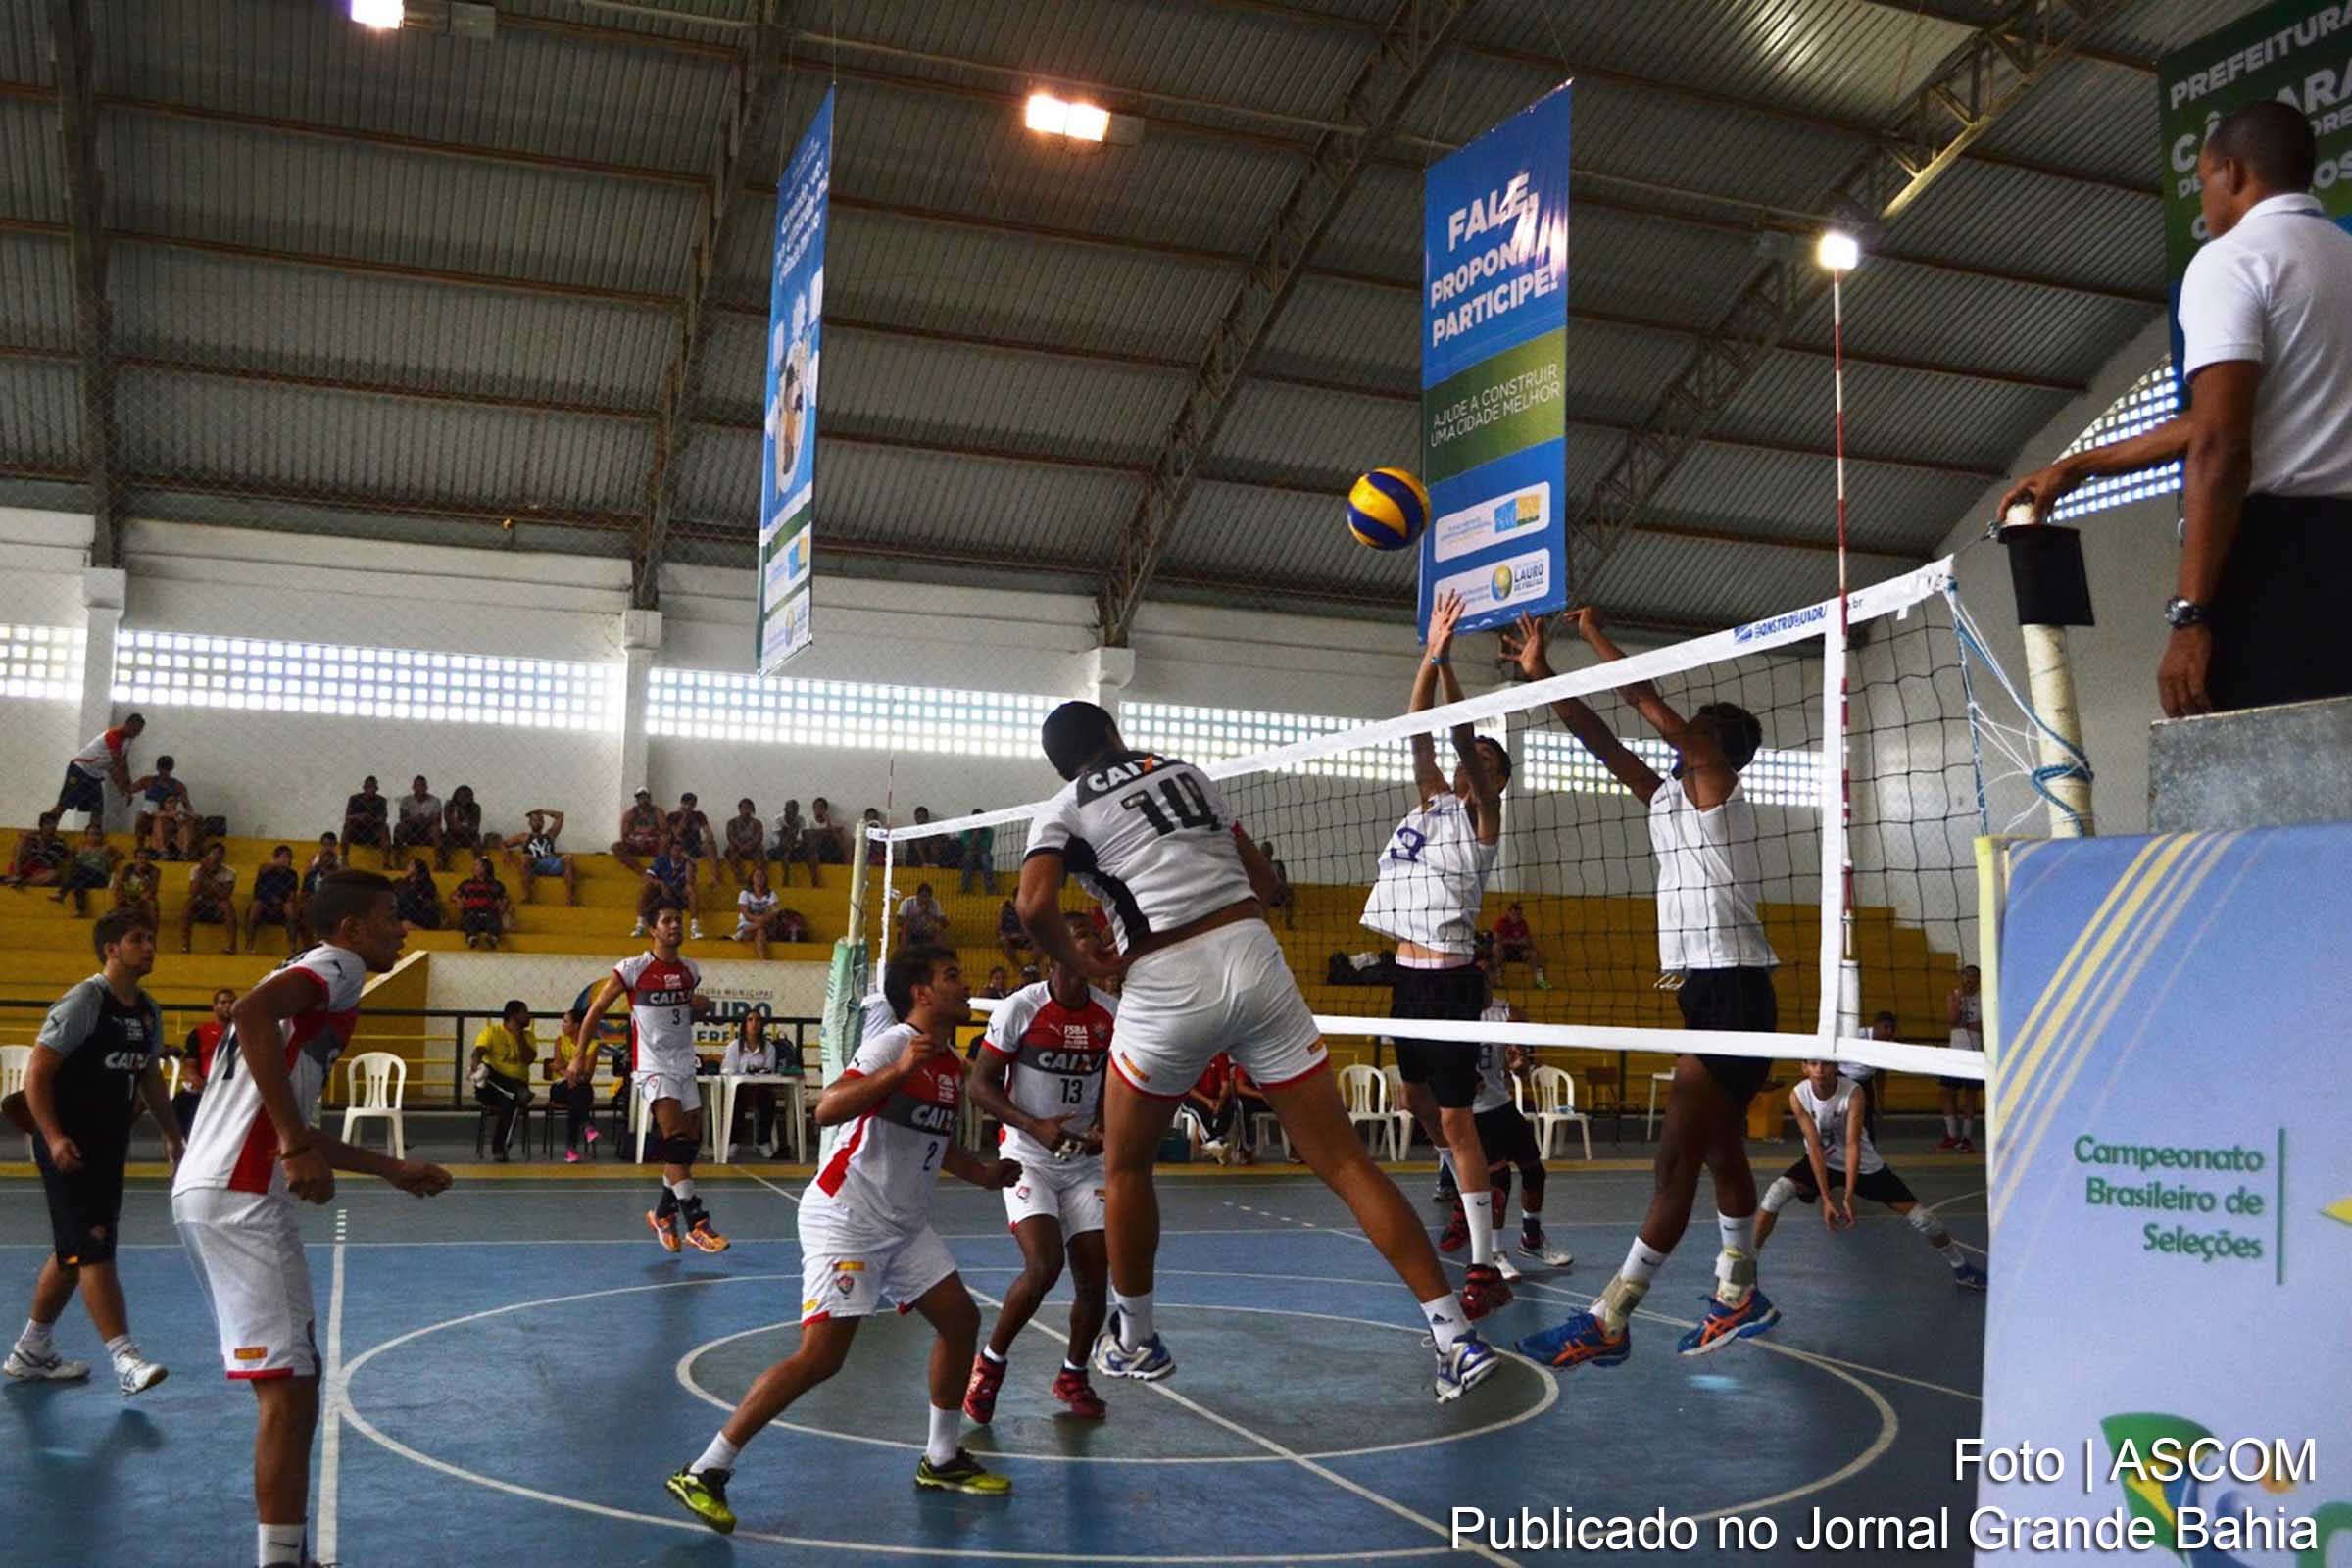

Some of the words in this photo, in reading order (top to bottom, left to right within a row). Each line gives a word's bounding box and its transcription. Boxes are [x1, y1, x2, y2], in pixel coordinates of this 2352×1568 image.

[1432, 259, 1559, 349] PARTICIPE!
[1430, 424, 1457, 447] UMA
[1456, 403, 1500, 435] CIDADE
[1502, 381, 1560, 416] MELHOR
[1433, 400, 1467, 428] AJUDE
[1471, 397, 1480, 411] A
[1481, 364, 1558, 407] CONSTRUIR
[671, 1008, 681, 1026] 3
[1060, 1078, 1083, 1104] 13
[922, 1141, 938, 1171] 2
[2074, 1134, 2266, 1172] Campeonato
[2085, 1176, 2217, 1214] Brasileiro
[2225, 1185, 2265, 1216] de
[2142, 1222, 2265, 1262] Seleções
